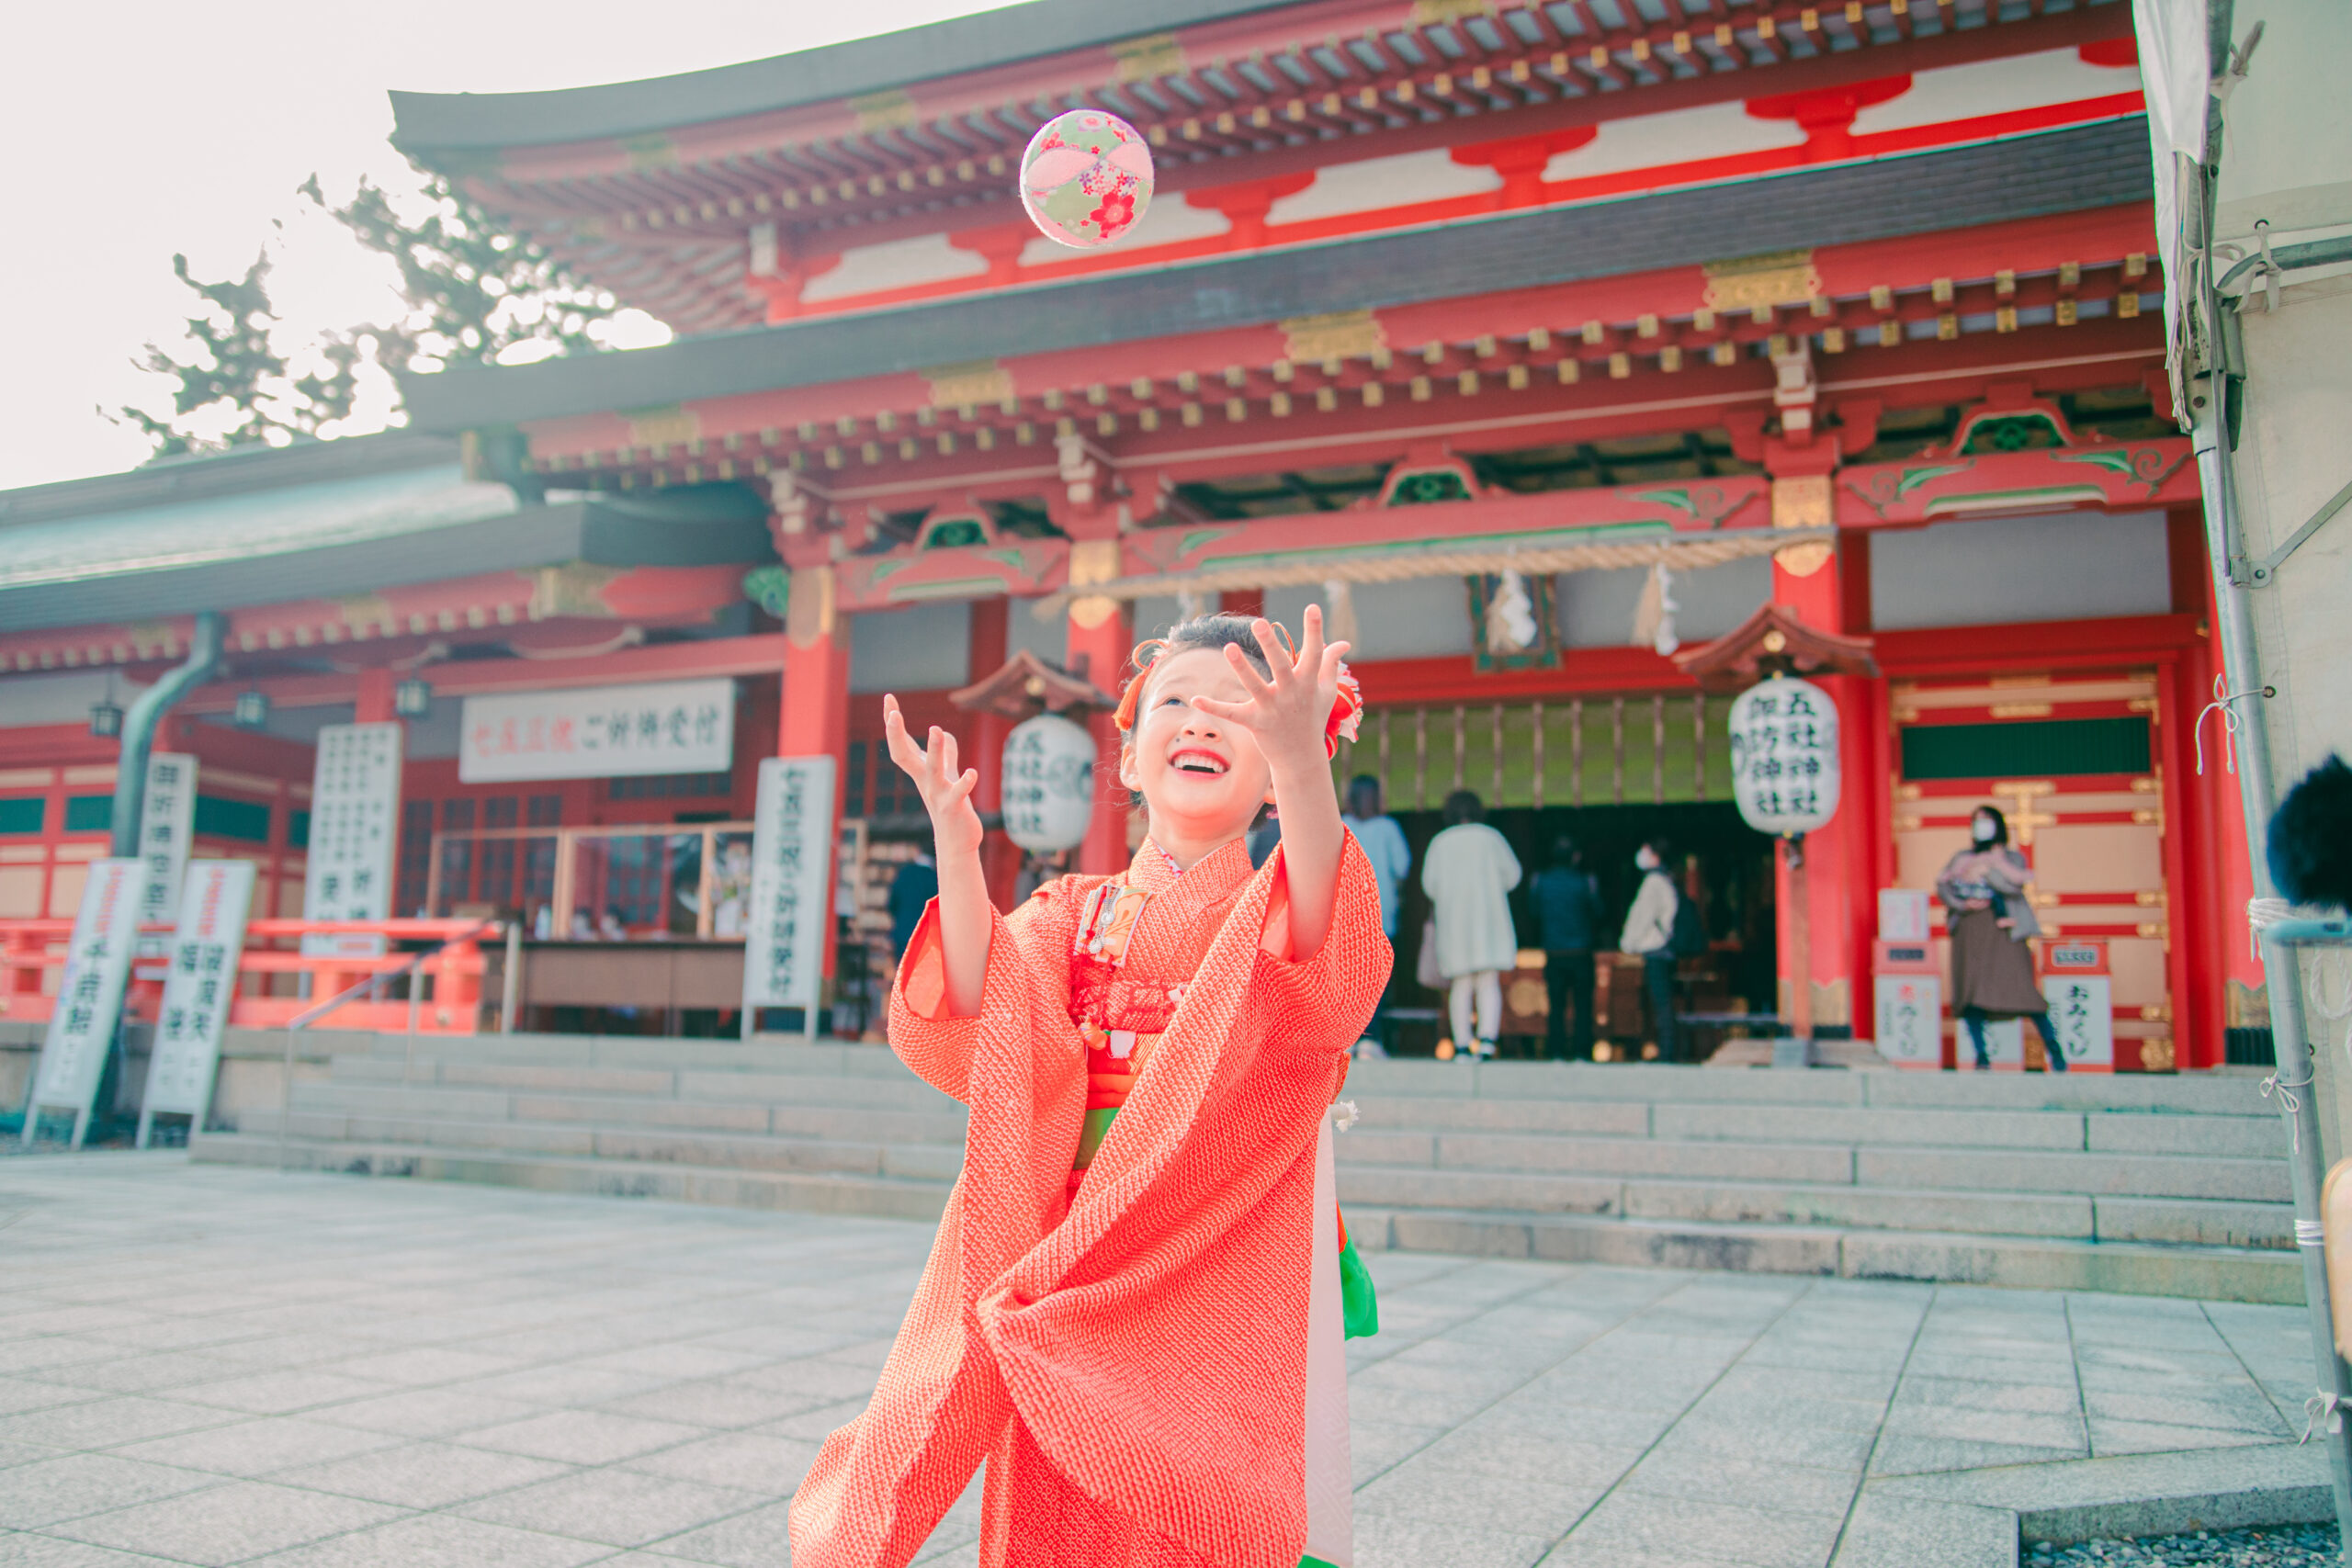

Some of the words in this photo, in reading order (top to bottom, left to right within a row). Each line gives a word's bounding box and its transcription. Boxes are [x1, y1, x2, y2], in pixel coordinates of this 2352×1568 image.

[1749, 696, 1785, 816] 諏訪神社
[1785, 691, 1821, 816] 五社神社
[66, 937, 109, 1035] 千歳飴
[2066, 985, 2090, 1057] おみくじ
